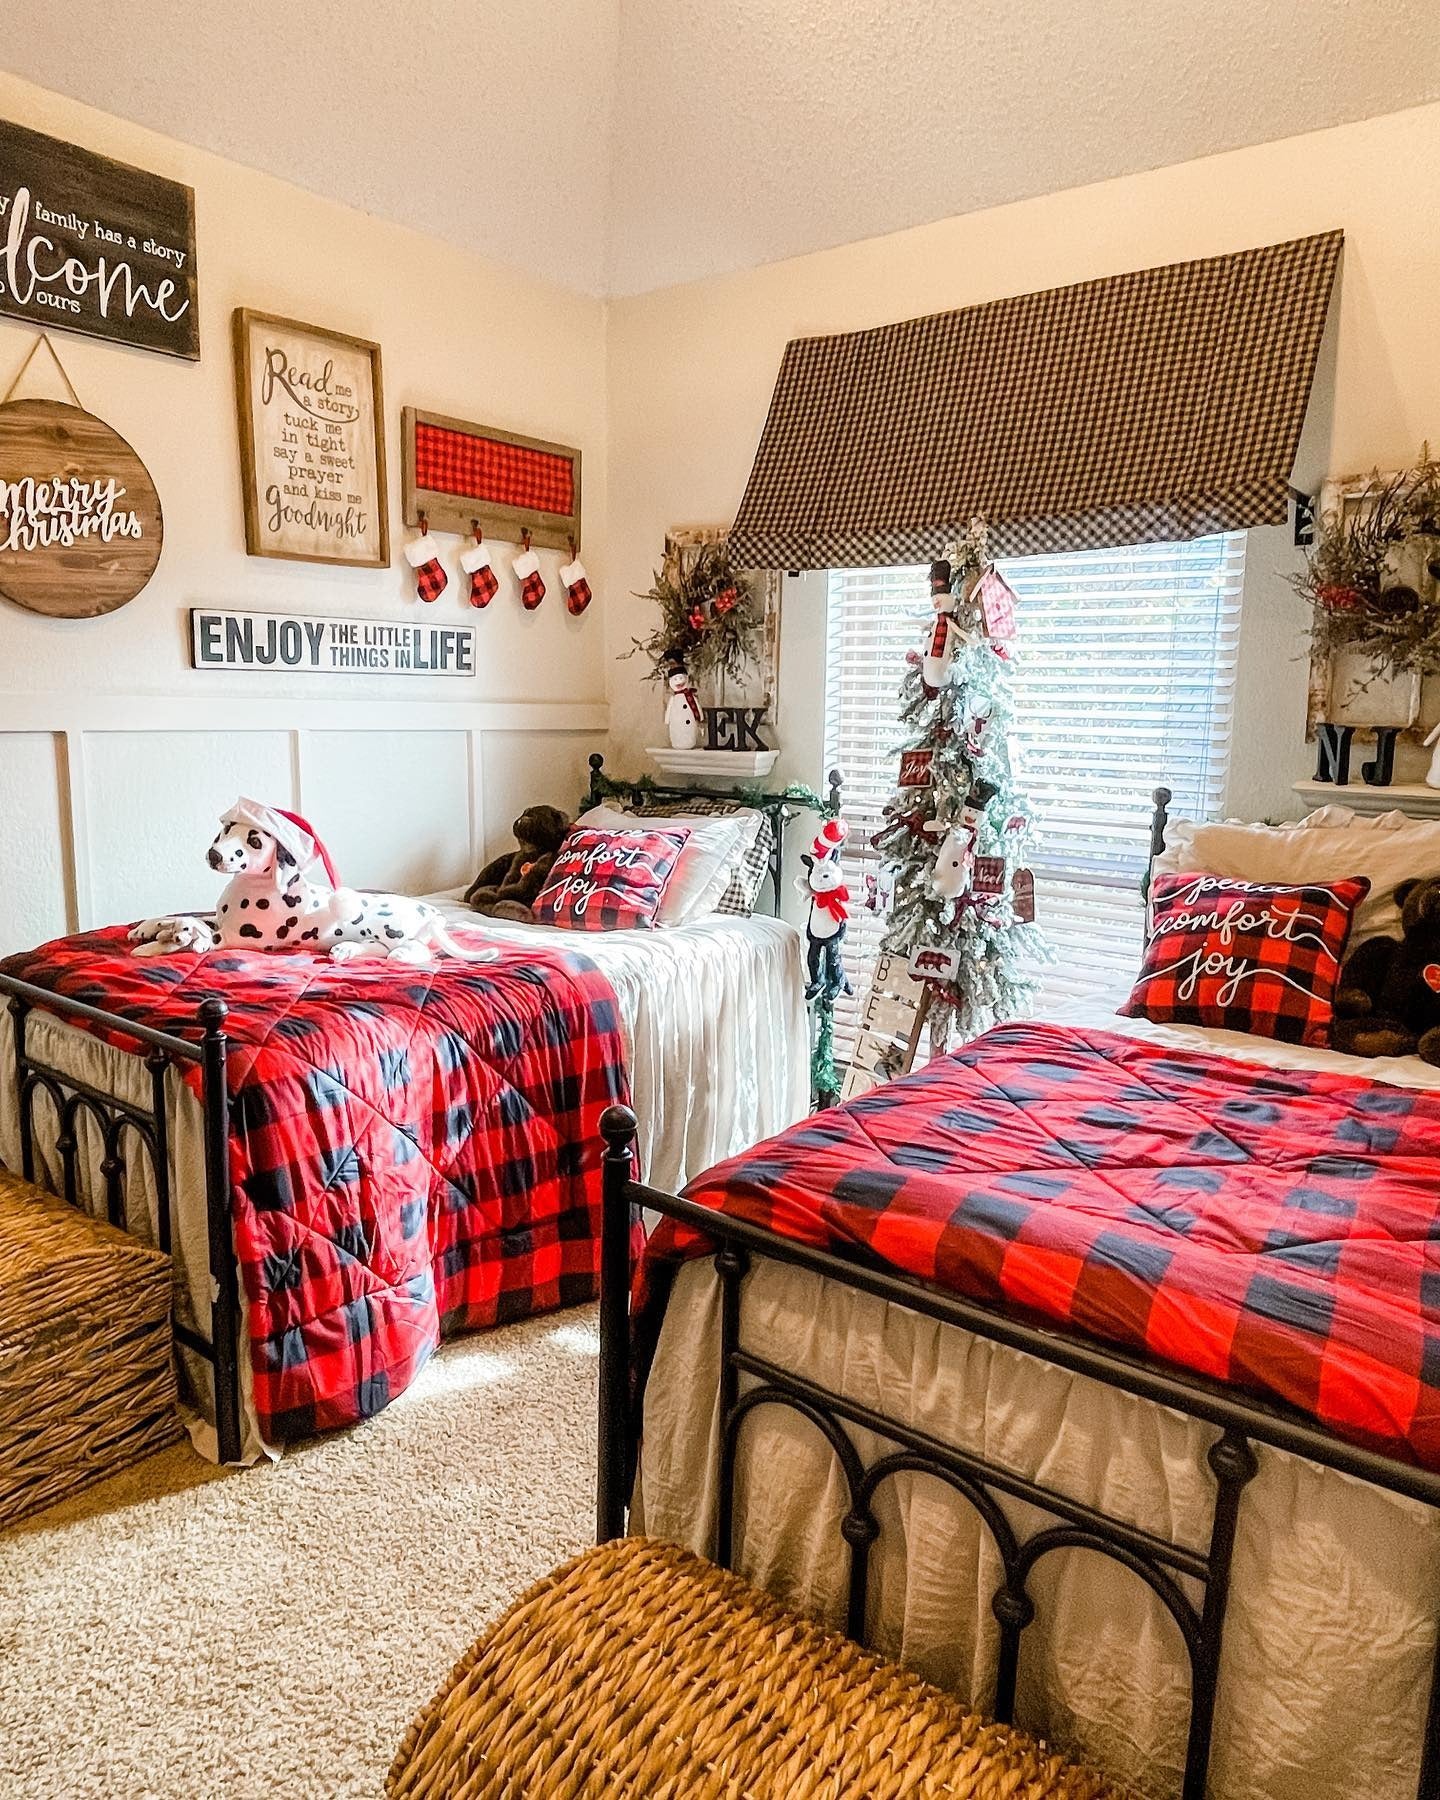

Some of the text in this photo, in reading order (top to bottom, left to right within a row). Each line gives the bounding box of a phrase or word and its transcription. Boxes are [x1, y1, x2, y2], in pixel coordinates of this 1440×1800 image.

[34, 200, 89, 239] family
[94, 221, 123, 245] has
[126, 236, 137, 250] a
[142, 239, 187, 269] story
[0, 186, 190, 322] lcome
[36, 291, 82, 314] ours
[261, 346, 353, 405] Read me
[302, 395, 356, 419] a story
[283, 412, 343, 435] tuck me
[281, 428, 346, 453] in tight
[273, 446, 356, 470] say a sweet
[287, 464, 345, 484] prayer
[283, 484, 363, 505] and kiss me
[0, 500, 143, 552] hristmas
[200, 615, 326, 666] ENJOY
[329, 623, 411, 648] THE LITTLE
[329, 646, 411, 669] THINGS IN
[413, 629, 472, 670] LIFE
[901, 760, 928, 779] Joy
[1153, 901, 1324, 945] comfort
[847, 956, 891, 1097] BELI
